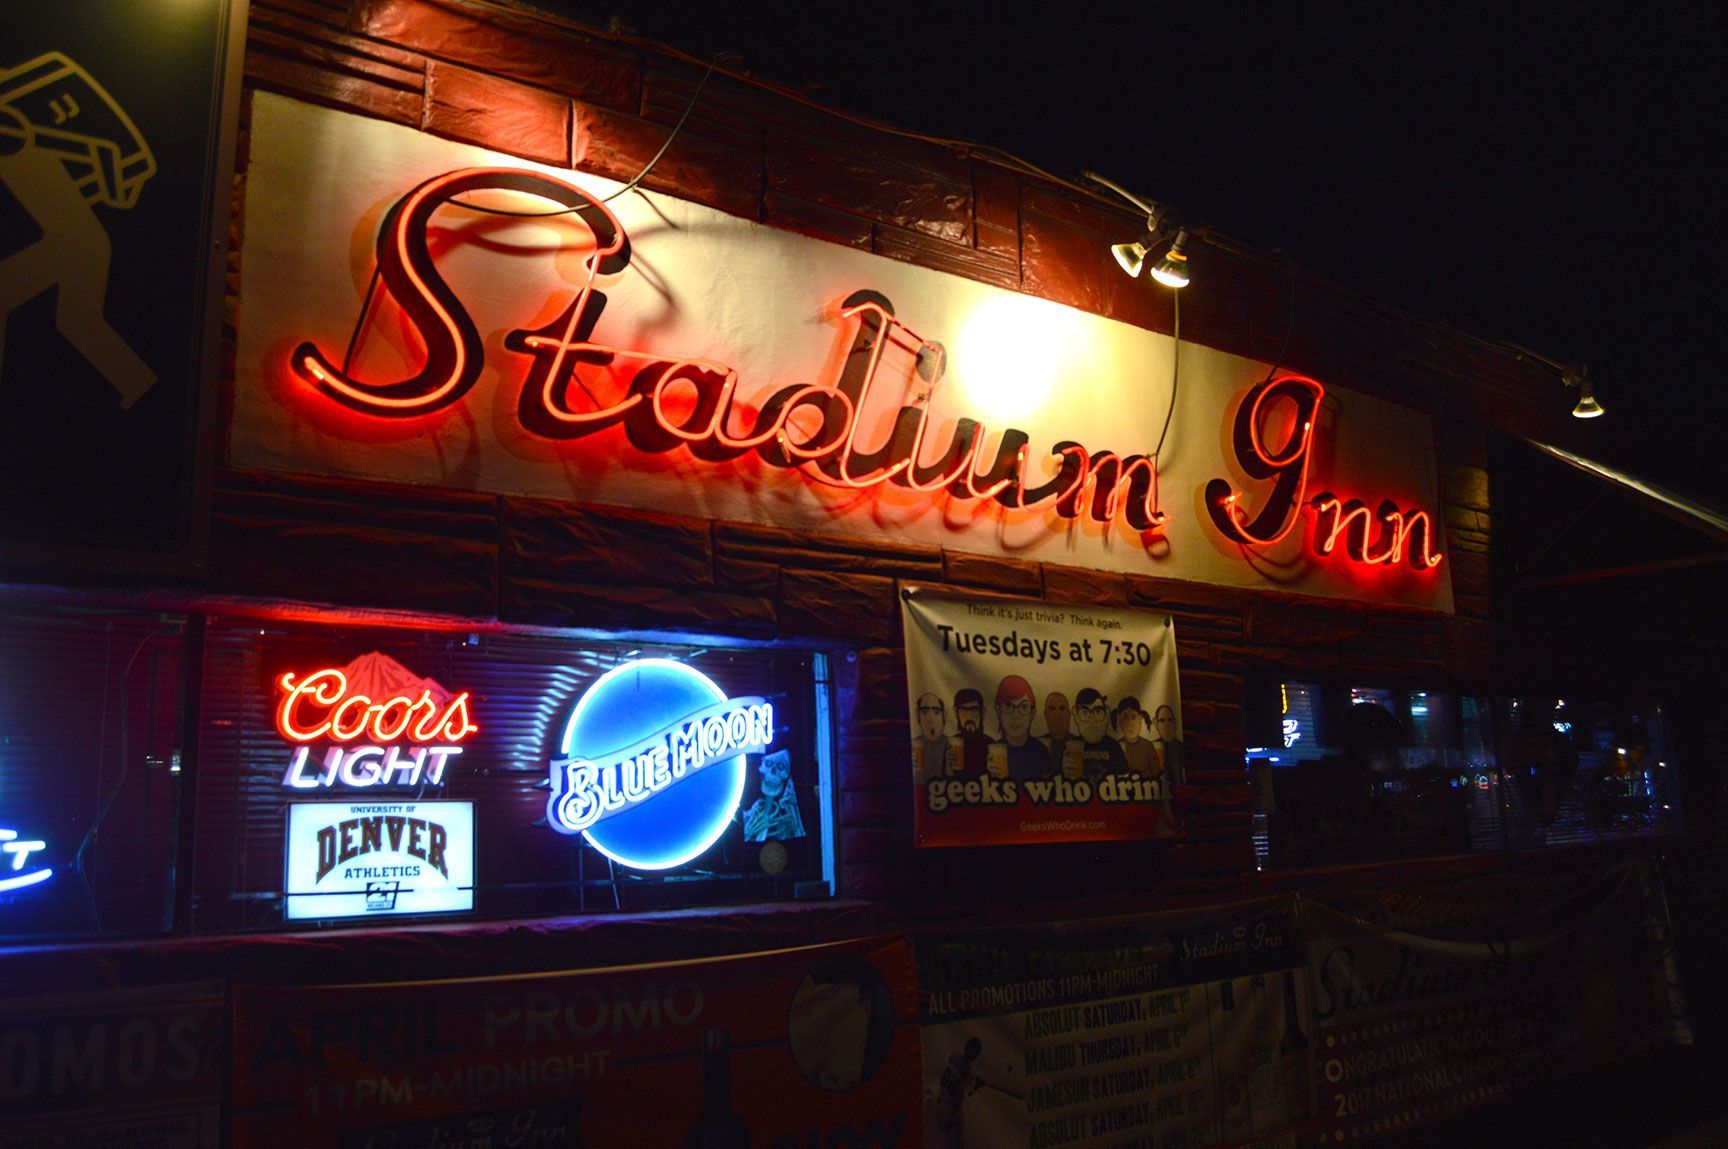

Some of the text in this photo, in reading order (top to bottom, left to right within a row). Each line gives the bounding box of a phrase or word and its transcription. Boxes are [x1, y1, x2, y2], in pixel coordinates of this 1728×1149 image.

[290, 166, 1441, 569] Stadium Inn
[967, 604, 1123, 630] Think it's just trivia? Think again.
[937, 625, 1151, 667] Tuesdays at 7:30
[277, 669, 477, 741] Coors
[284, 746, 463, 788] LIGHT
[557, 703, 773, 831] BLUE MOON
[350, 806, 402, 814] UNIVERSITY
[928, 774, 1017, 811] geeks
[1024, 776, 1091, 803] who
[1020, 819, 1107, 832] GeeksWhoDrink.com
[316, 816, 448, 885] DENVER
[344, 865, 421, 879] ATHLETICS
[1178, 931, 1248, 962] Stadium
[928, 963, 1159, 1017] ALL PROMOTIONS 11PM-MIDNIGHT
[251, 977, 706, 1073] APRIL PROMO
[1024, 1007, 1080, 1040] ABSOLUT
[1085, 999, 1146, 1029] SATURDAY,
[1150, 992, 1177, 1017] APRIL
[0, 1015, 201, 1098] OMOS
[1025, 1043, 1075, 1076] MALIBU
[1080, 1033, 1141, 1066] THURSDAY,
[1145, 1029, 1172, 1053] APRIL
[304, 1049, 611, 1118] 11PM-MIDNIGHT
[1026, 1077, 1090, 1113] JAMESON
[1092, 1065, 1154, 1100] SATURDAY,
[1375, 1066, 1451, 1106] NATIONAL
[1030, 1113, 1087, 1149] ABSOLUT
[1091, 1101, 1154, 1137] SATURDAY,
